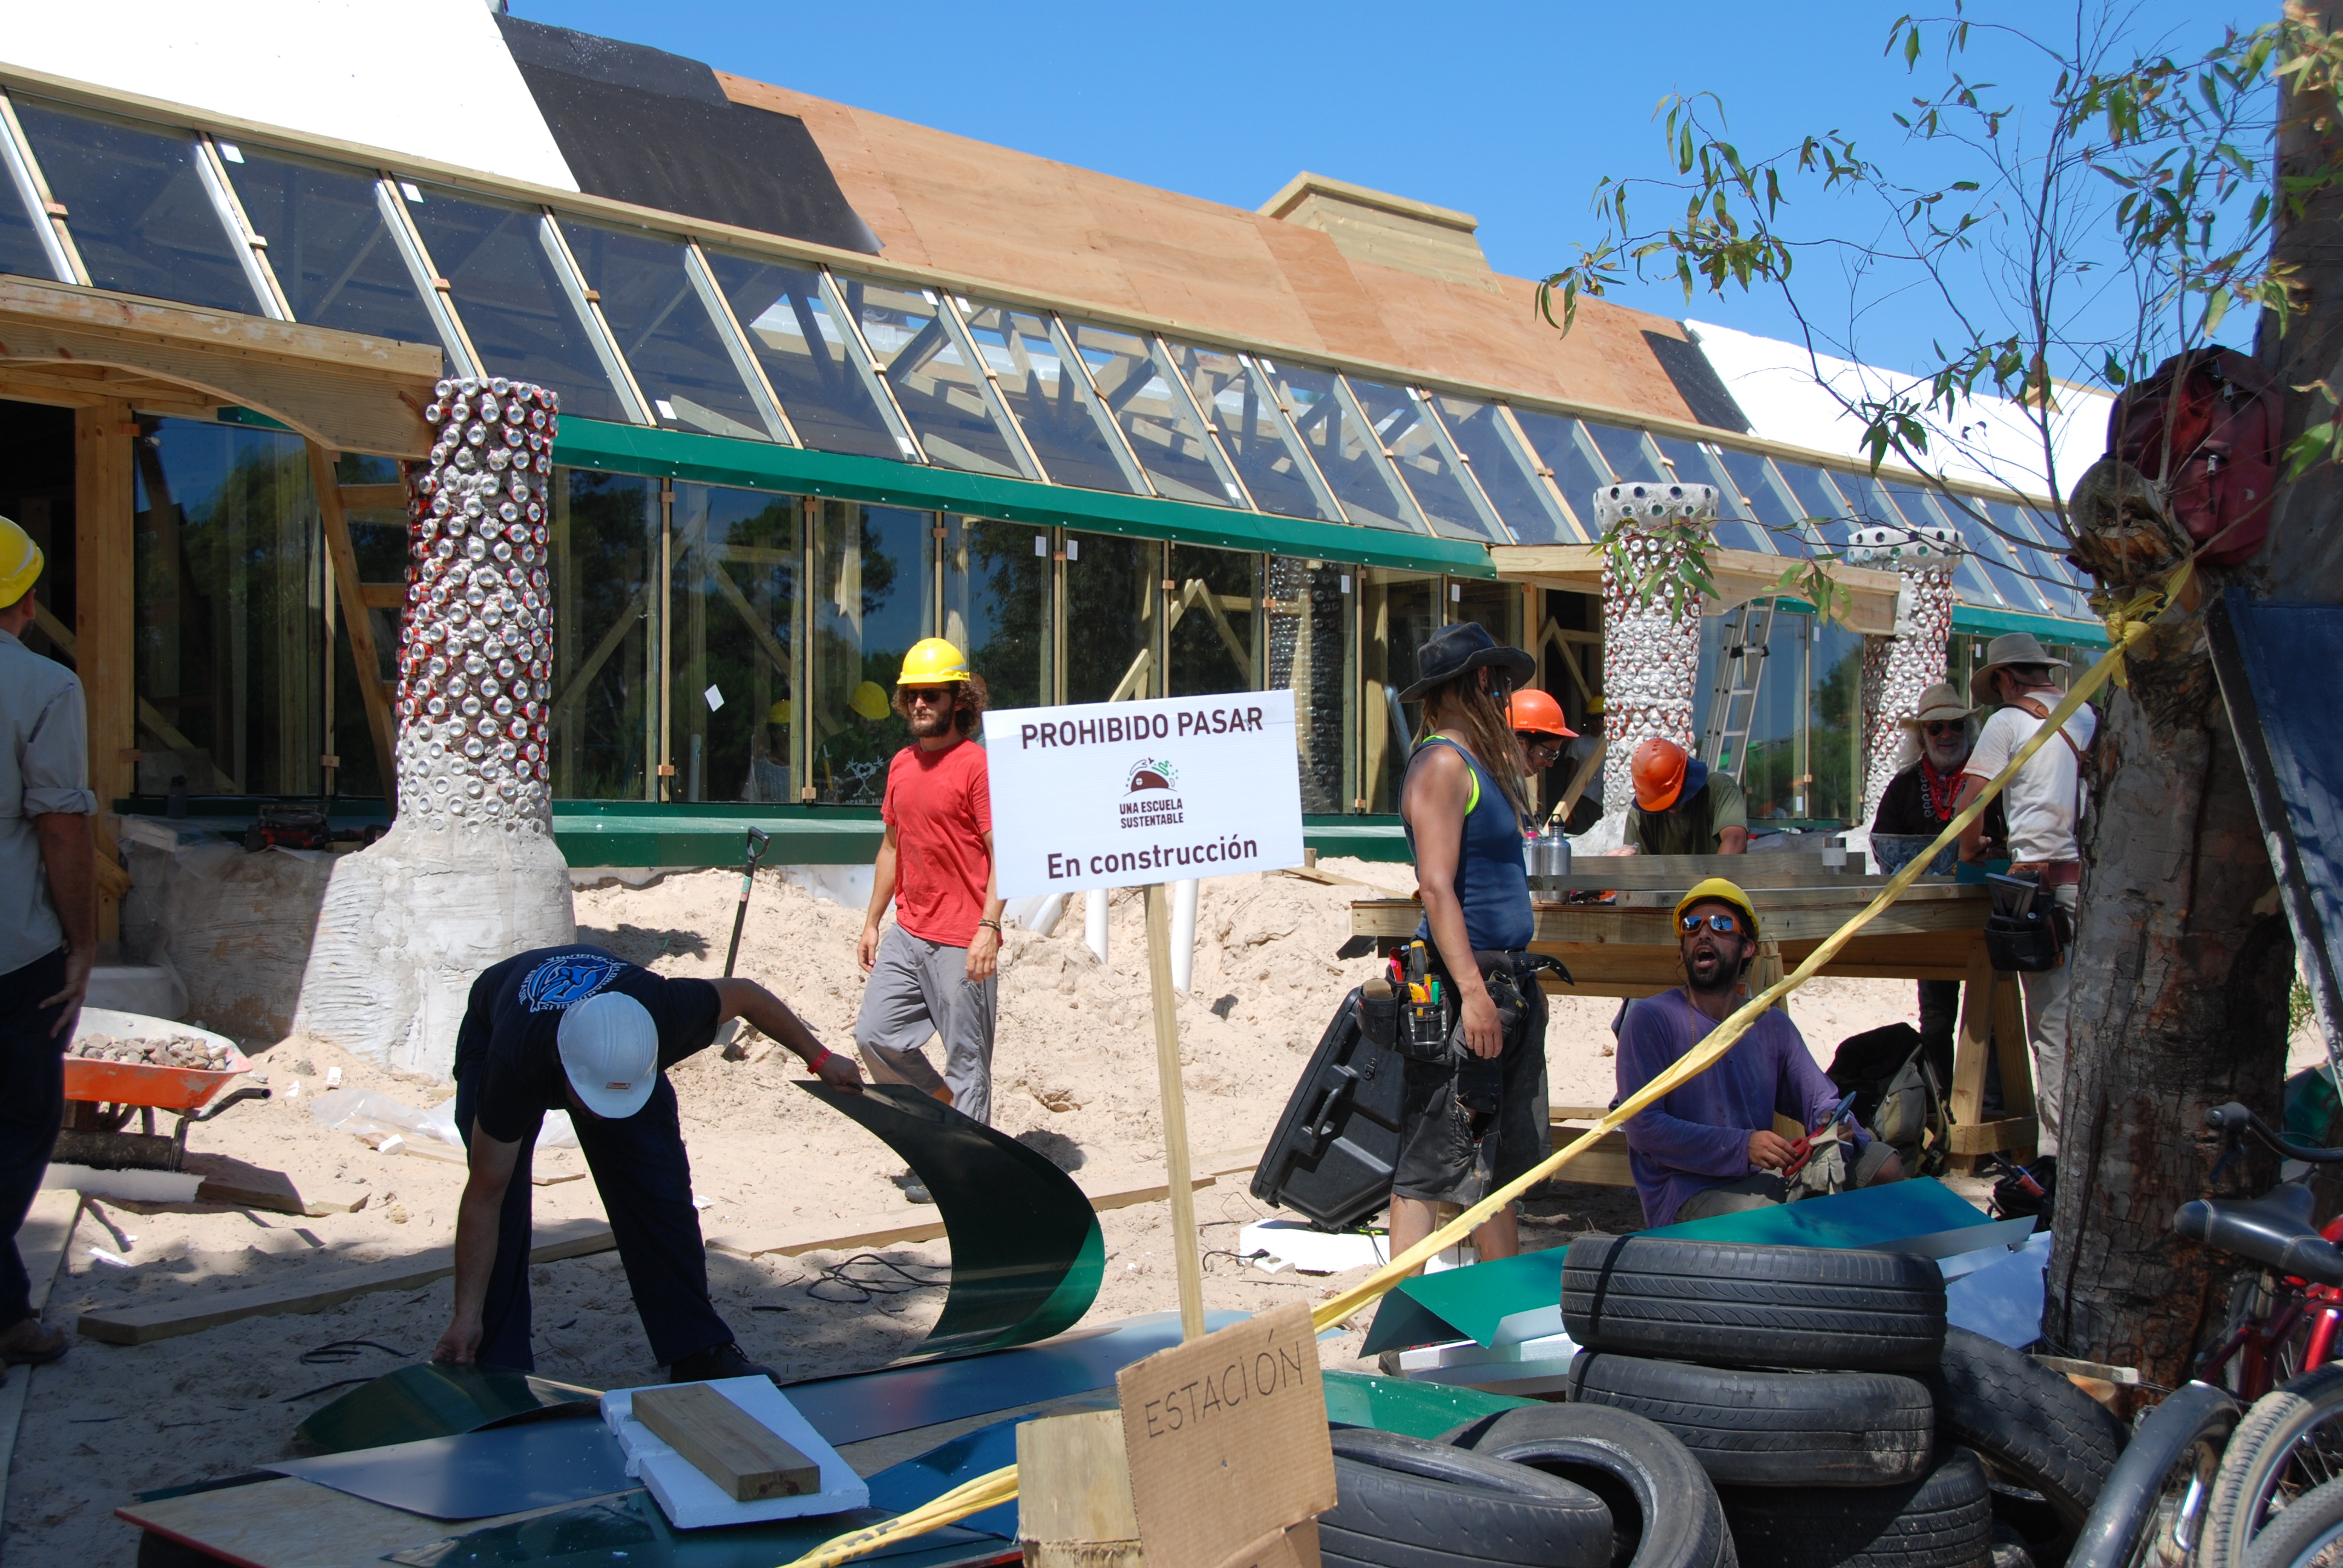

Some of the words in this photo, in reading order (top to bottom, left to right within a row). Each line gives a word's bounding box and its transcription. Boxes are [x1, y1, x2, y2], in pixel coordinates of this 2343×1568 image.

[1021, 713, 1168, 750] PROHIBIDO
[1178, 707, 1263, 737] PASAR
[1119, 803, 1139, 815] UNA
[1141, 798, 1183, 813] ESCUELA
[1121, 812, 1184, 829] SUSTENTABLE
[1047, 852, 1081, 880] En
[1090, 834, 1257, 875] construcción
[1145, 1328, 1304, 1438] ESTACIÓN
